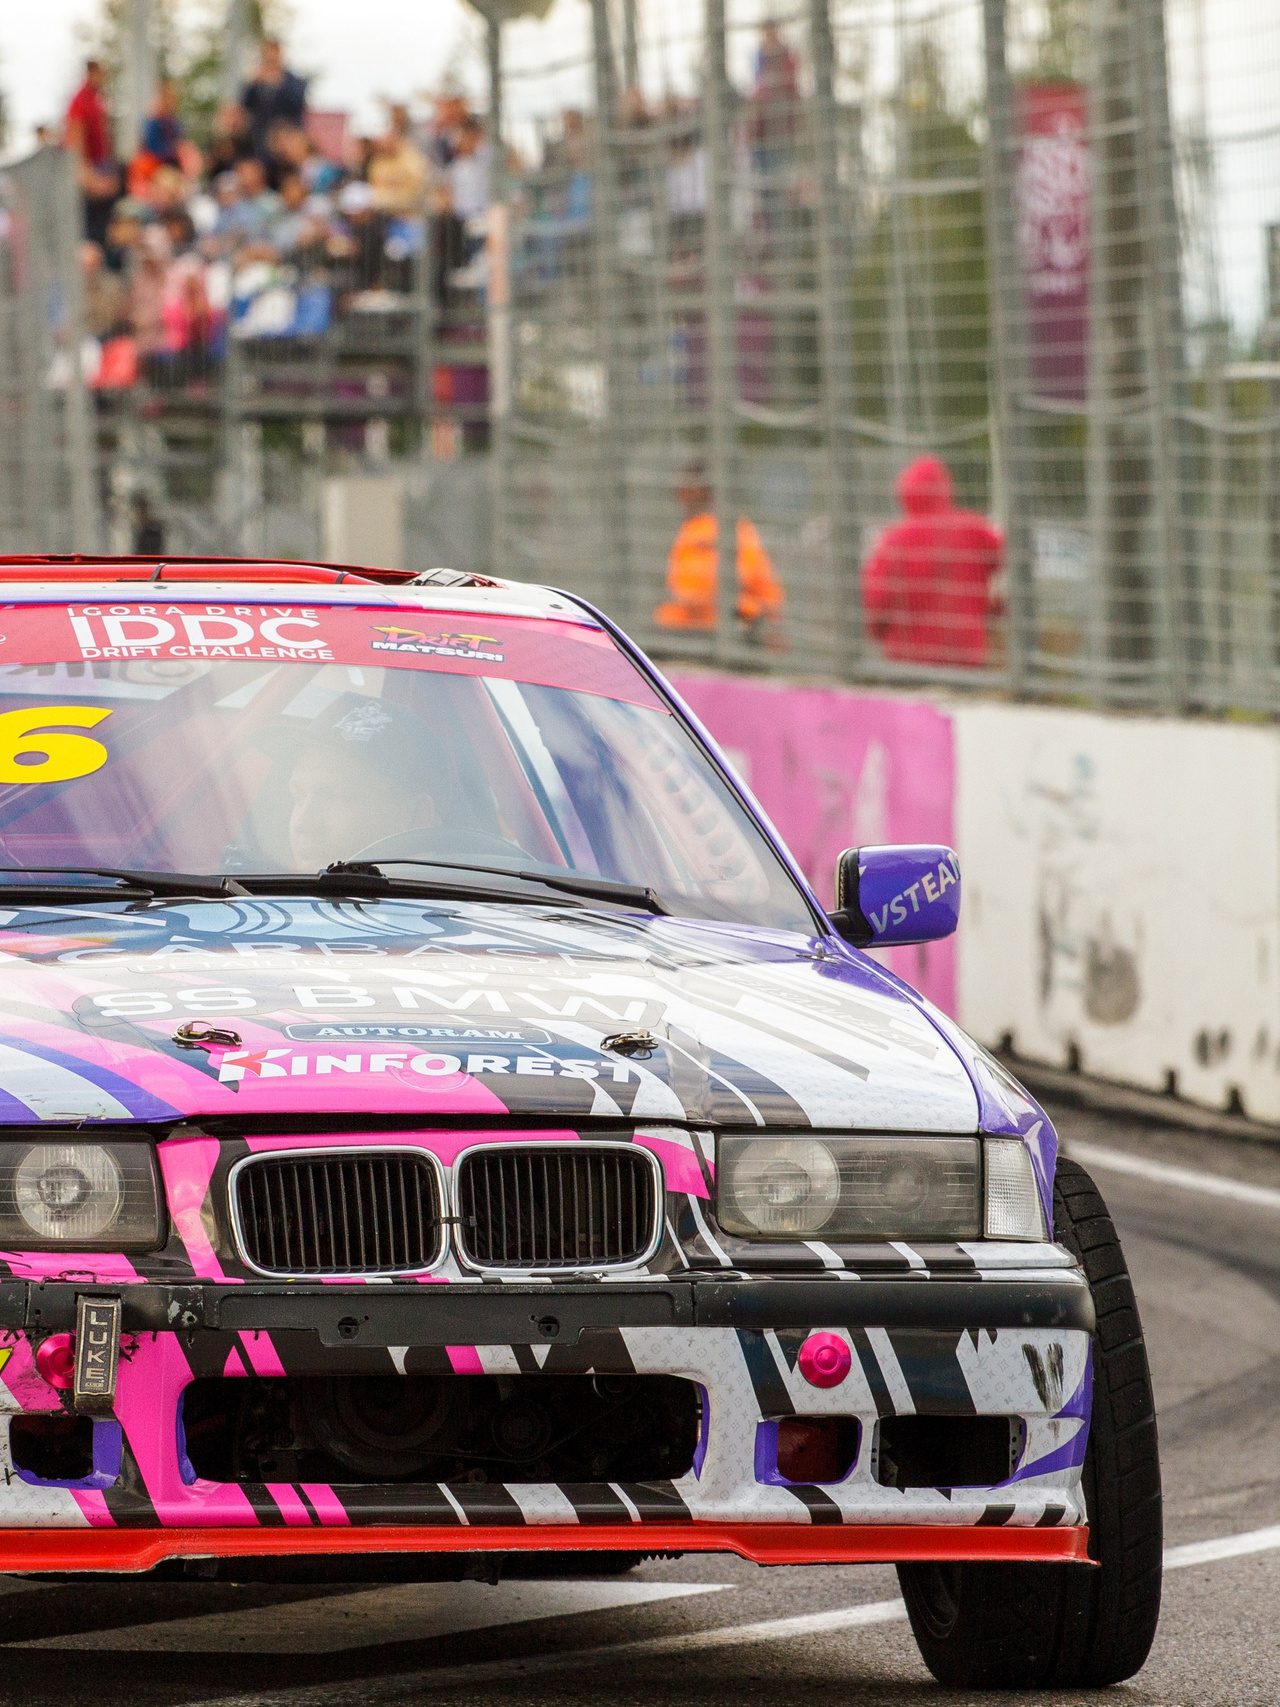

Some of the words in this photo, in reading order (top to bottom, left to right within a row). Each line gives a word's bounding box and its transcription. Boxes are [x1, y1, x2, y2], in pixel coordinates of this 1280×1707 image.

[67, 607, 181, 617] IGORA
[206, 606, 319, 619] DRIVE
[69, 614, 329, 650] IDDC
[80, 645, 162, 659] DRIFT
[169, 645, 336, 661] CHALLENGE
[371, 641, 504, 662] MATSURI
[57, 941, 628, 971] CARBASE
[136, 958, 364, 972] DETAILING
[411, 960, 581, 978] CENTER
[92, 987, 257, 1017] SS
[291, 985, 649, 1022] BMW
[316, 1025, 524, 1040] AUTORAM
[218, 1047, 640, 1084] KINFOREST
[85, 1310, 109, 1380] LUKE
